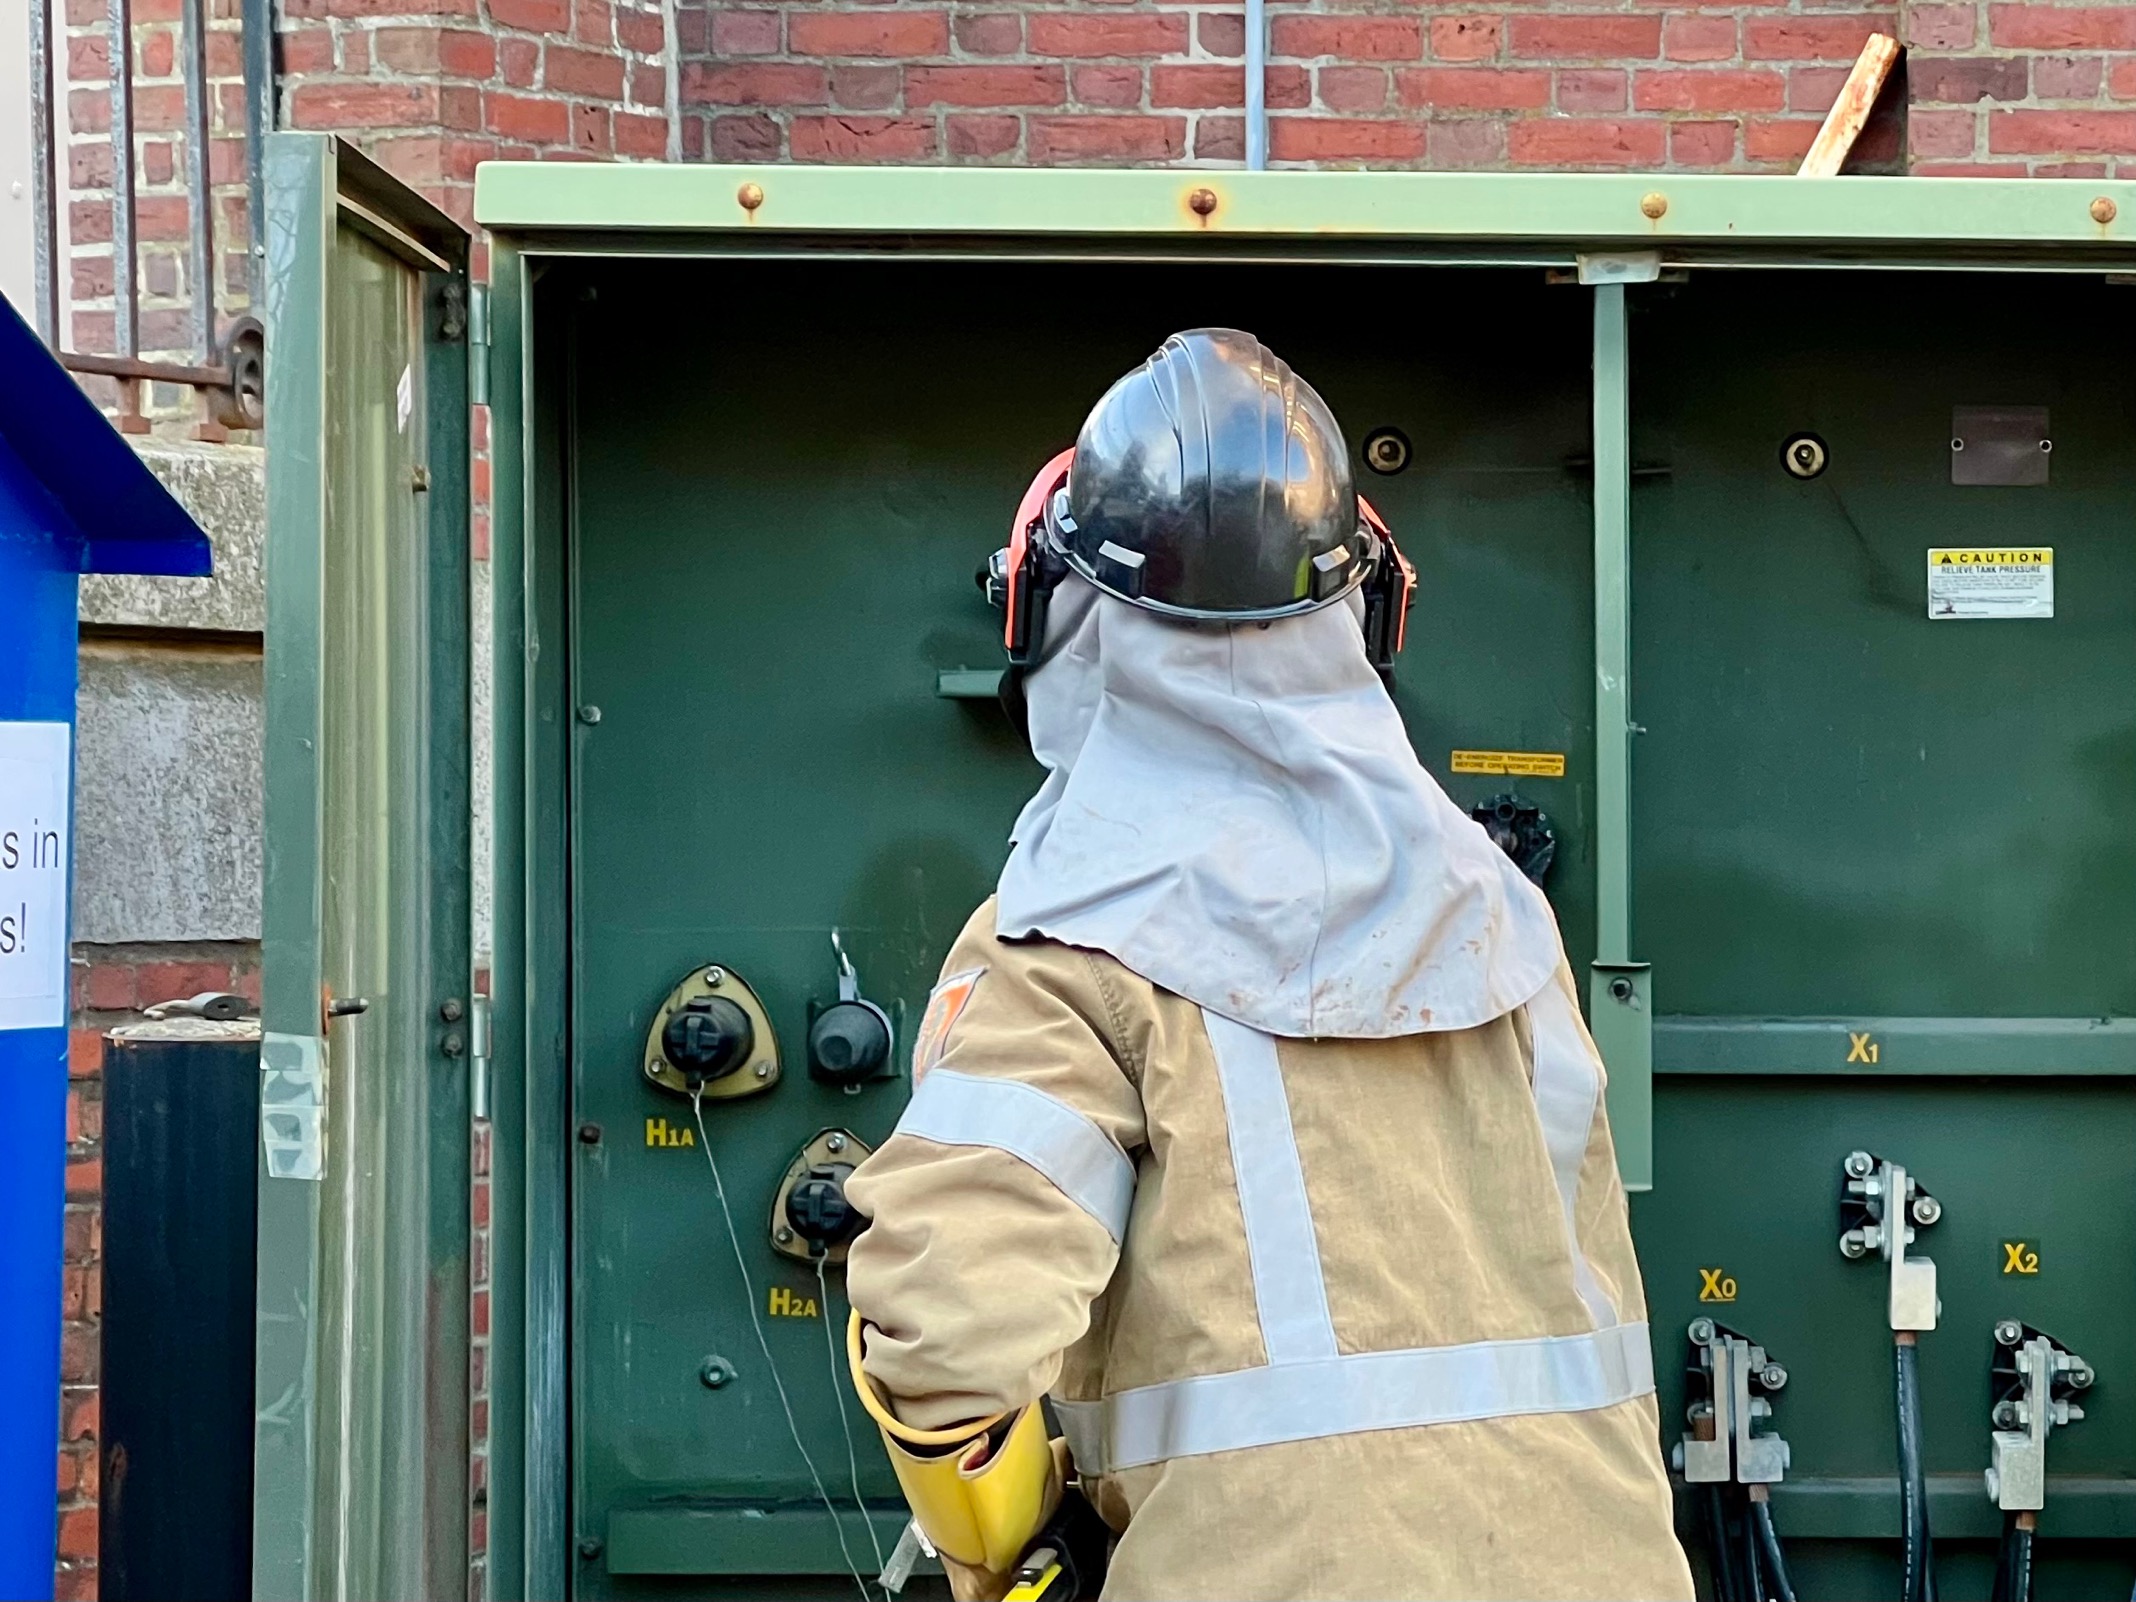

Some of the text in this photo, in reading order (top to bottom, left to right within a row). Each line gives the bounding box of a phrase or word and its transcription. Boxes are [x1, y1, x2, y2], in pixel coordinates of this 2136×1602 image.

[1942, 565, 2041, 574] RELIEVE TANK PRESSURE
[1959, 552, 2042, 563] CAUTION
[33, 818, 58, 869] in
[1847, 1031, 1878, 1063] X1
[646, 1118, 694, 1147] H1A
[2003, 1242, 2038, 1273] X2
[769, 1287, 817, 1318] H2A
